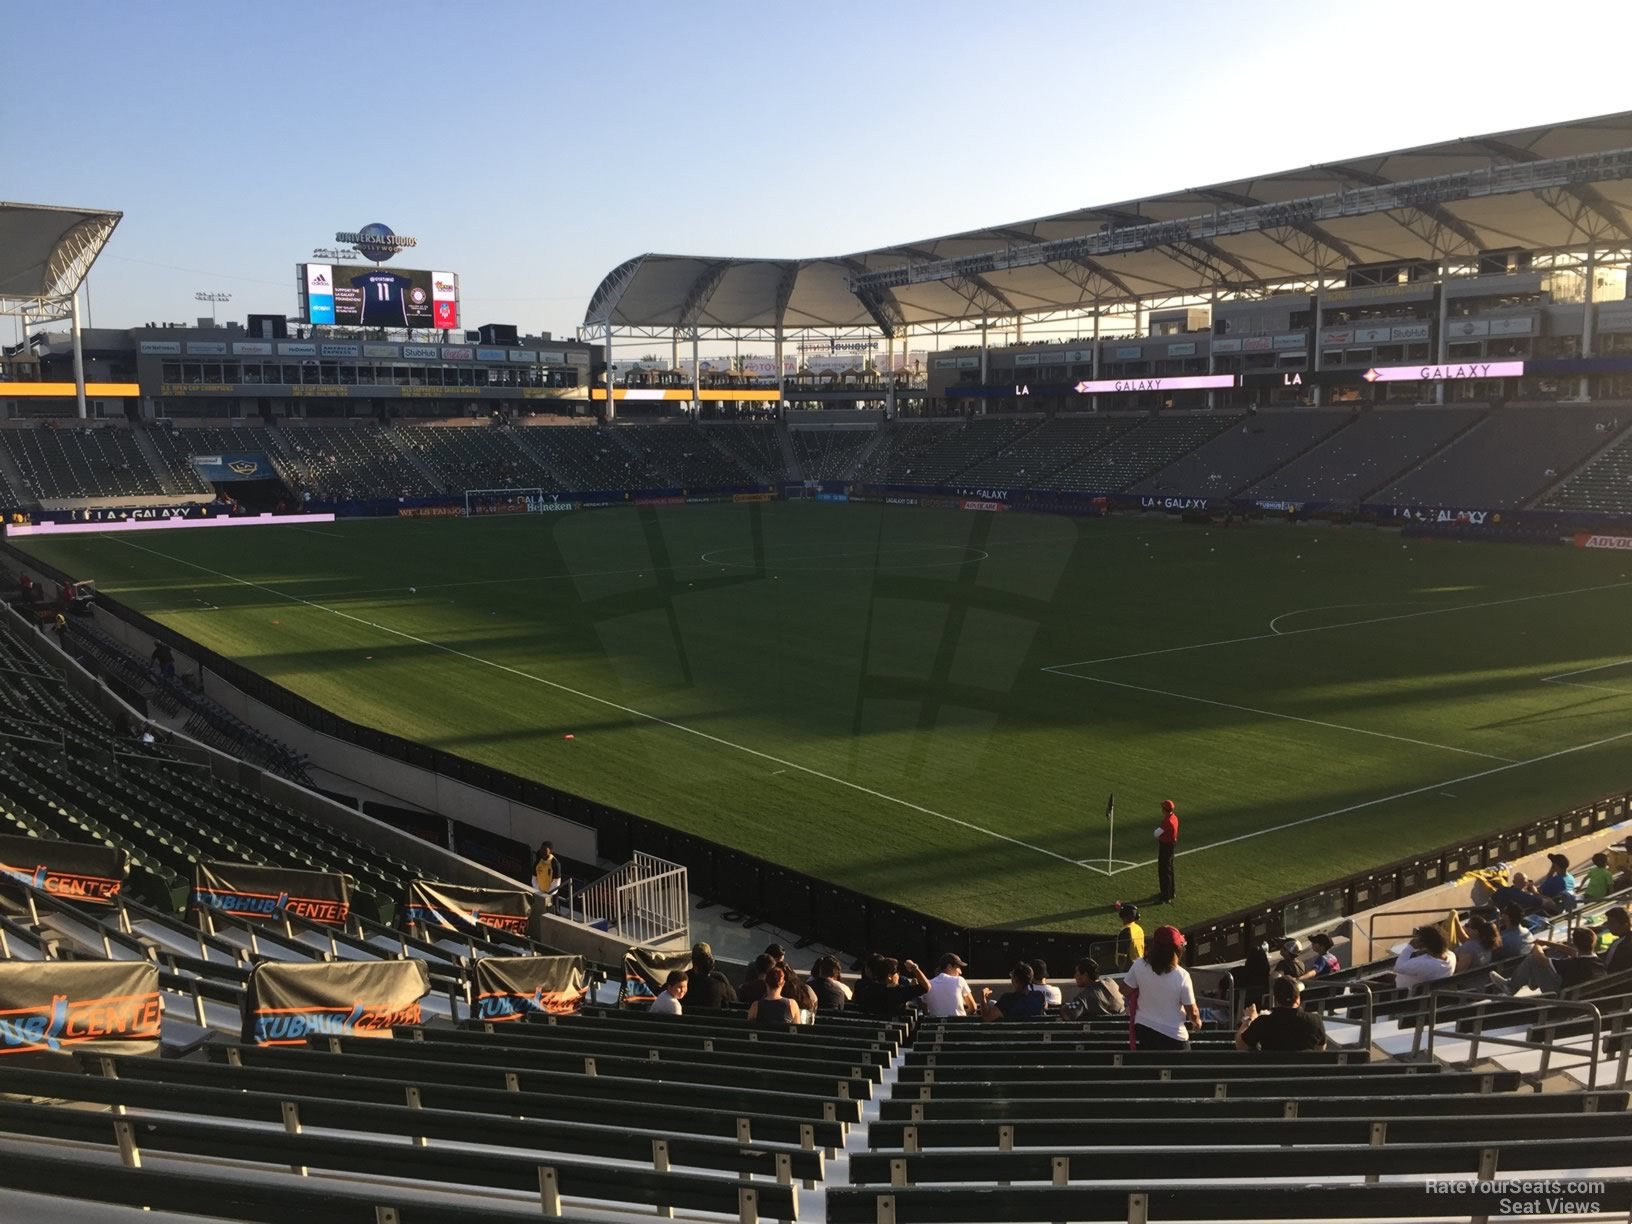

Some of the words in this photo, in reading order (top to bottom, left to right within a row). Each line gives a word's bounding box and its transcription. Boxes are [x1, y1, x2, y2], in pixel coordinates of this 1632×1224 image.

[336, 232, 386, 244] UNIVERSAL
[386, 235, 417, 247] STUDIOS
[377, 283, 390, 301] 11
[1393, 328, 1427, 338] StubHub
[404, 347, 436, 357] StubHub
[760, 363, 795, 371] TOYTA
[1420, 364, 1490, 379] GALAXY
[1284, 373, 1302, 386] LA
[1015, 384, 1029, 395] LA
[1115, 380, 1162, 391] GALAXY
[516, 494, 560, 504] GALAY
[976, 489, 1008, 499] GALAXY
[527, 502, 572, 512] Heneken
[1141, 497, 1154, 507] LA
[1164, 498, 1207, 509] GALAXY
[132, 508, 190, 518] GALAXY
[44, 876, 121, 898] CENTER
[285, 901, 349, 921] CENTER
